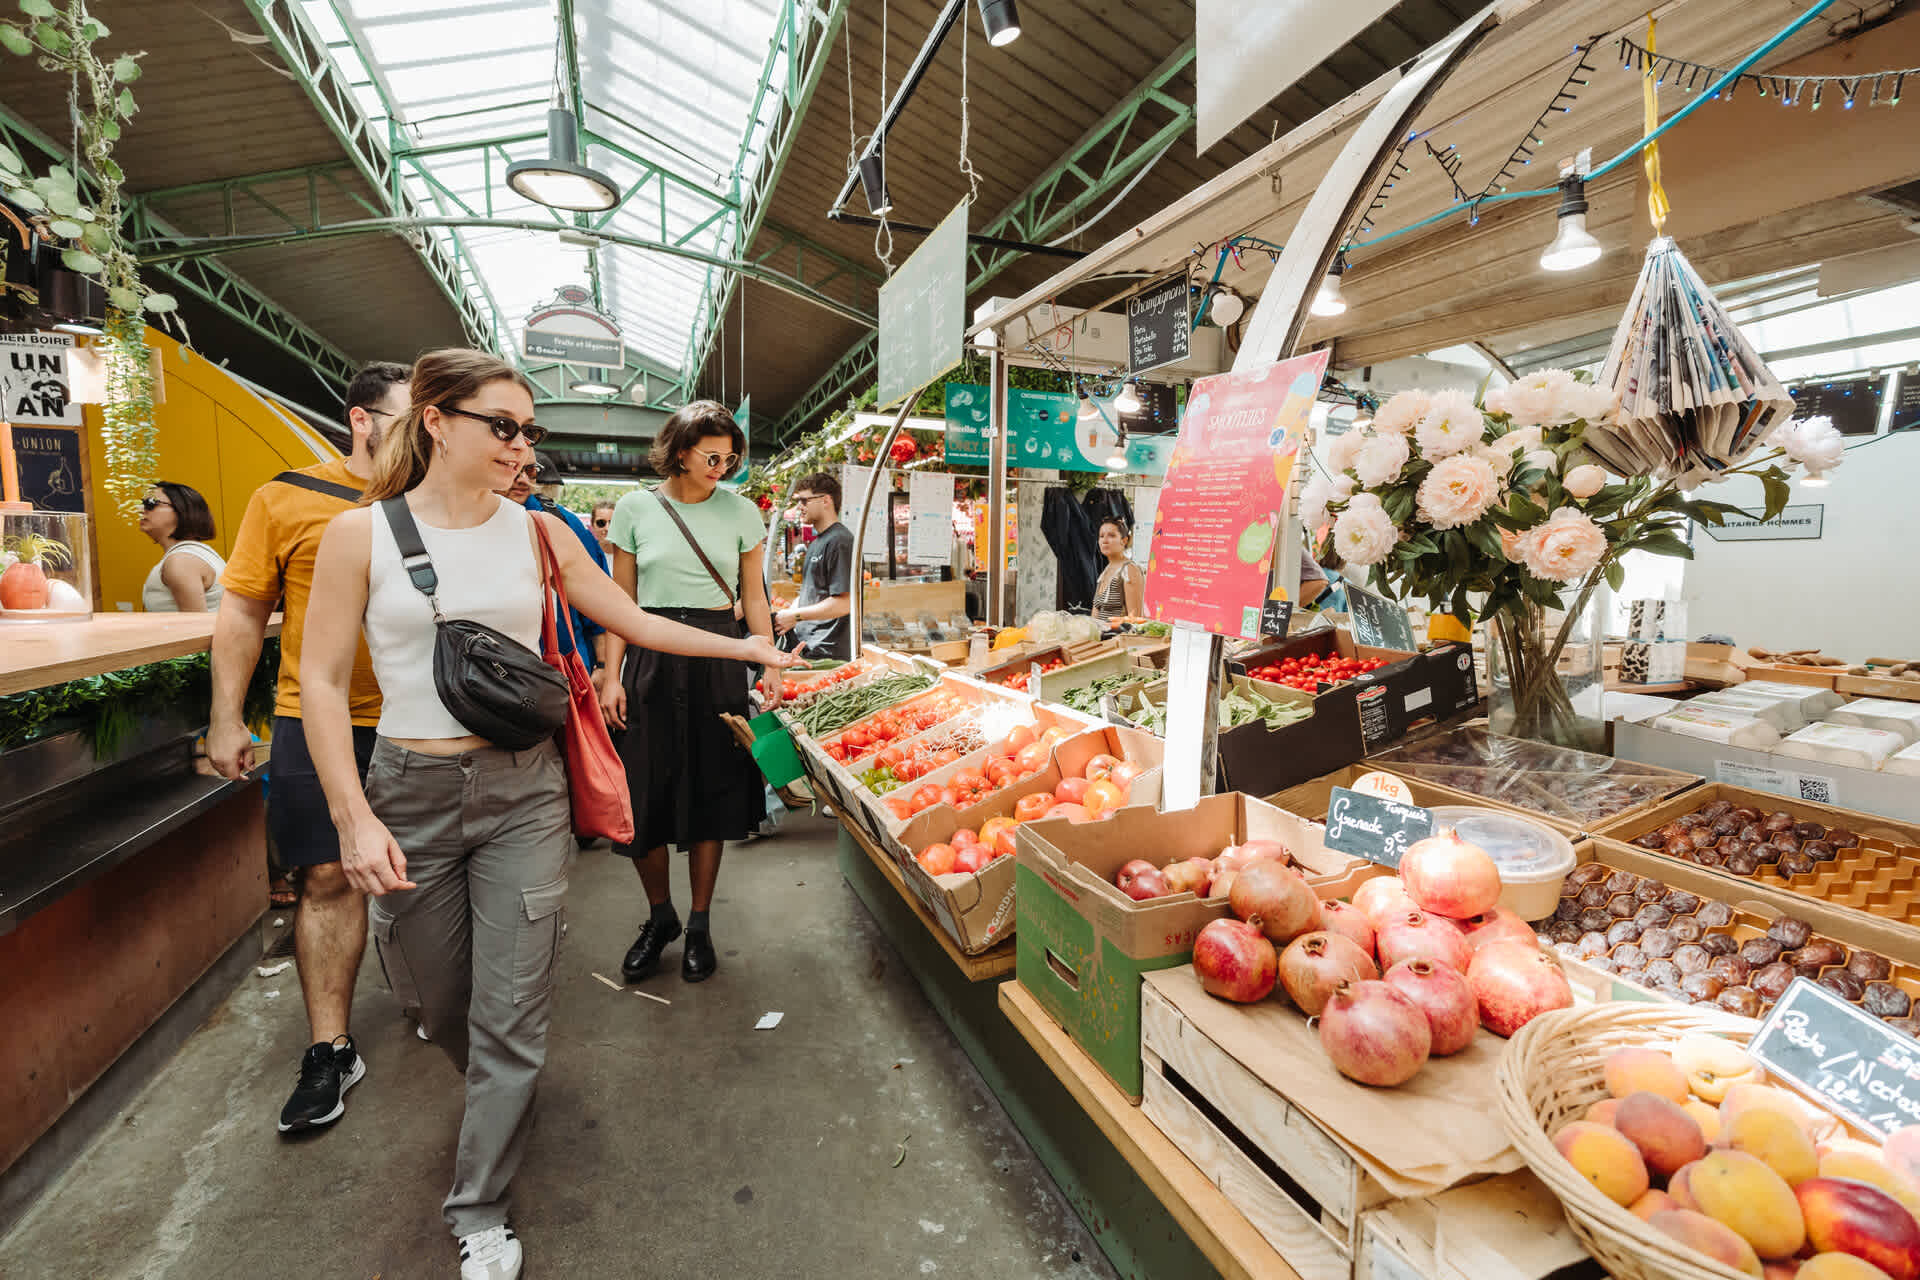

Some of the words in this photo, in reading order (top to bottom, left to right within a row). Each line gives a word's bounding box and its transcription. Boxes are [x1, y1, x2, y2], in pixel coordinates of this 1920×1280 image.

[1130, 283, 1186, 318] Champignons
[30, 335, 71, 346] BOIRE
[10, 352, 62, 374] UN
[16, 396, 65, 418] AN
[1767, 517, 1812, 528] HOMMES
[1372, 775, 1399, 798] 1kg
[1330, 797, 1384, 839] Grenade
